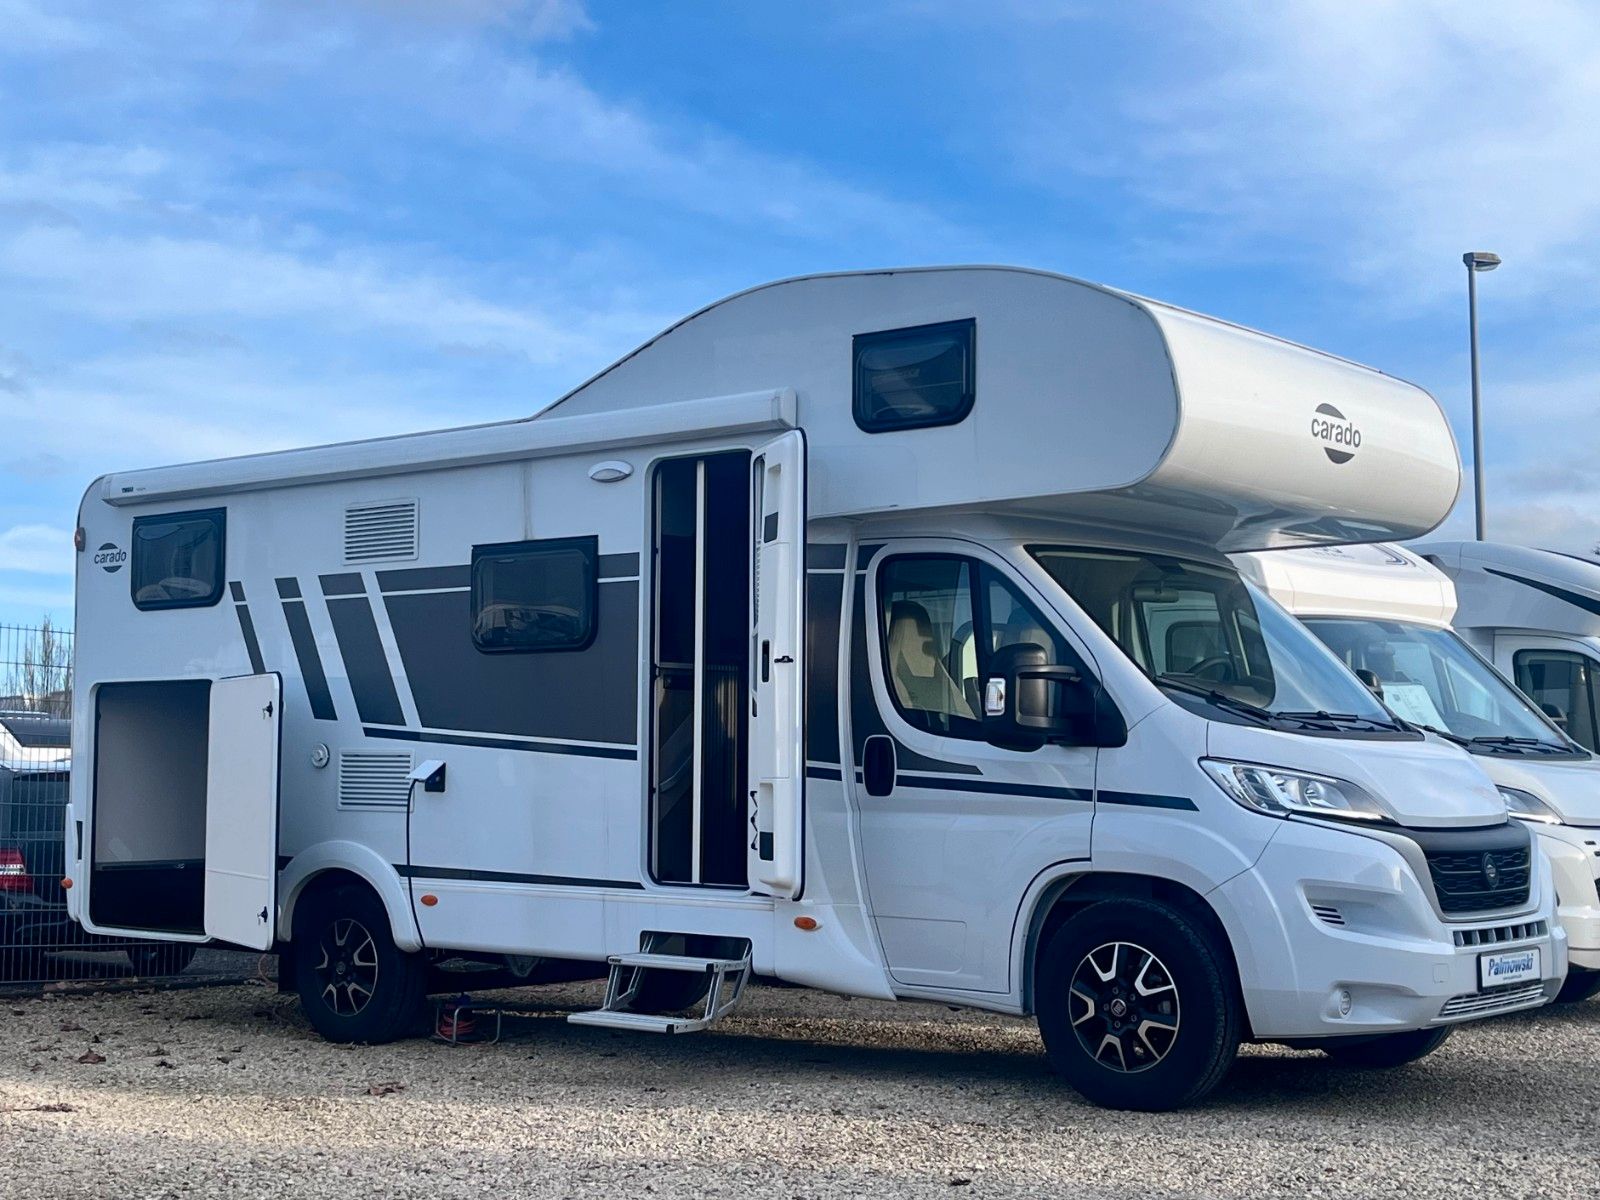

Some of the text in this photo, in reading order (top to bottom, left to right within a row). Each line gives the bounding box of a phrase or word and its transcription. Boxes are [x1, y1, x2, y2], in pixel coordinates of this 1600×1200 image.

[1311, 418, 1361, 448] carado
[94, 549, 127, 564] carado
[1488, 953, 1534, 977] Palmowski
